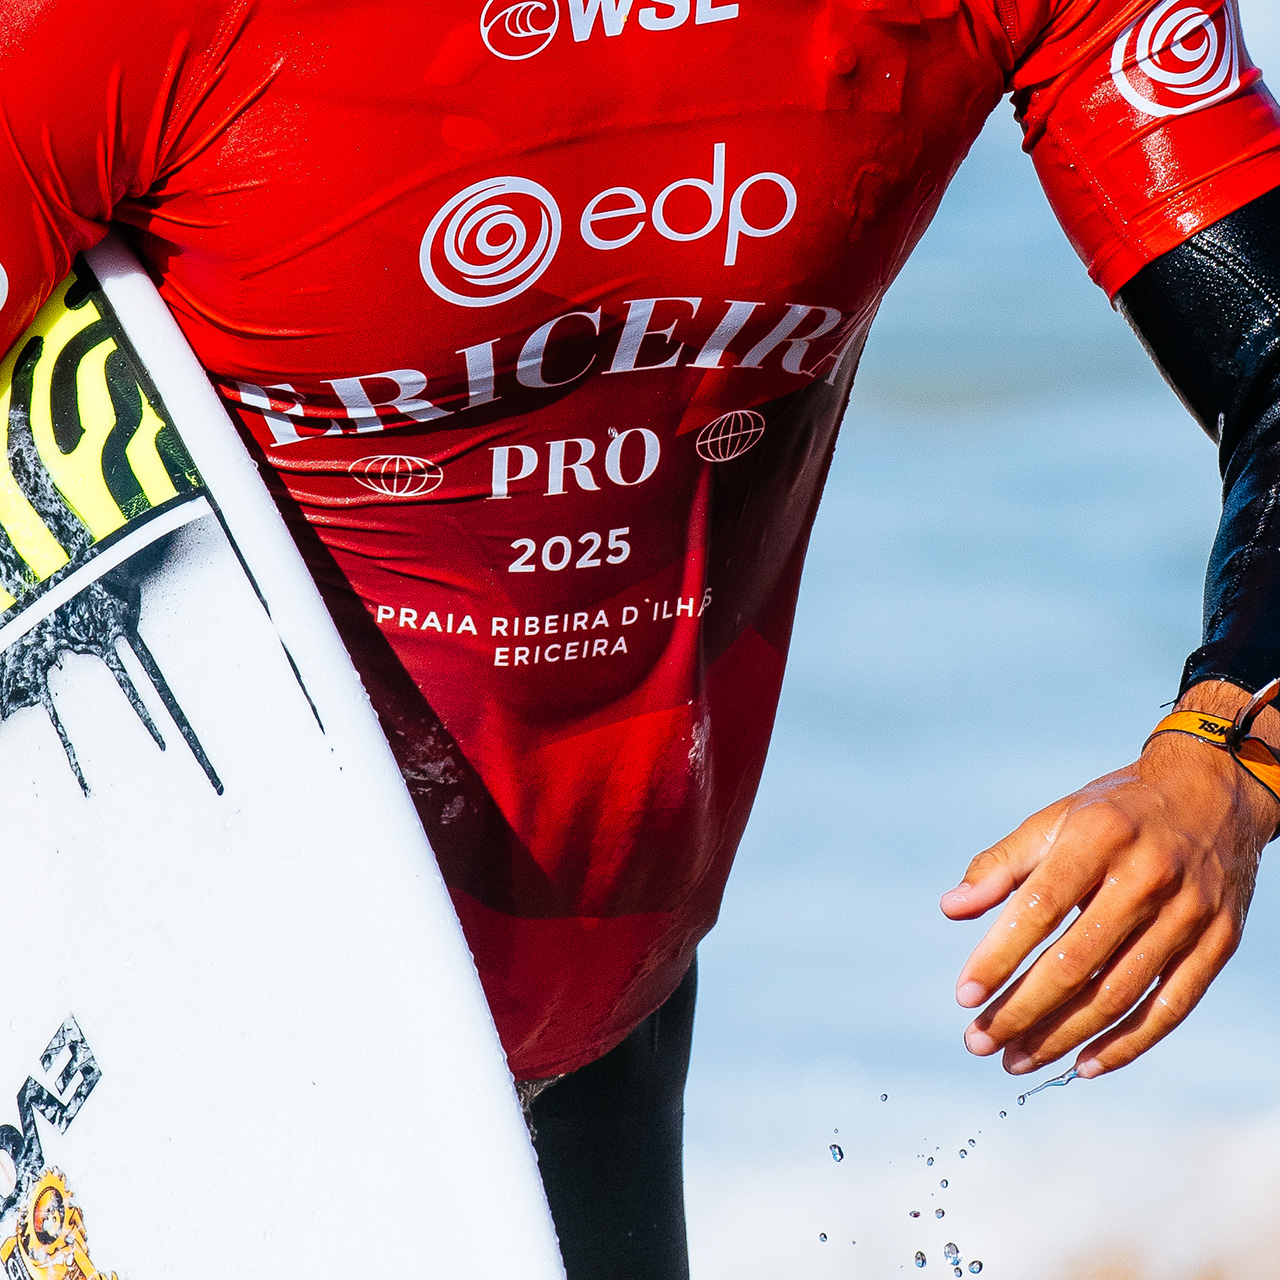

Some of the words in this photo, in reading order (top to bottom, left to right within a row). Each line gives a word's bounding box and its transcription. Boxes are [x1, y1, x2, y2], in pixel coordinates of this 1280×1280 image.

[579, 141, 798, 267] edp
[232, 294, 874, 448] ERICEIRA
[485, 426, 661, 502] PRO
[507, 526, 631, 574] 2025
[376, 604, 479, 636] PRAIA
[490, 608, 610, 637] RIBEIRA
[493, 636, 629, 667] ERICEIRA
